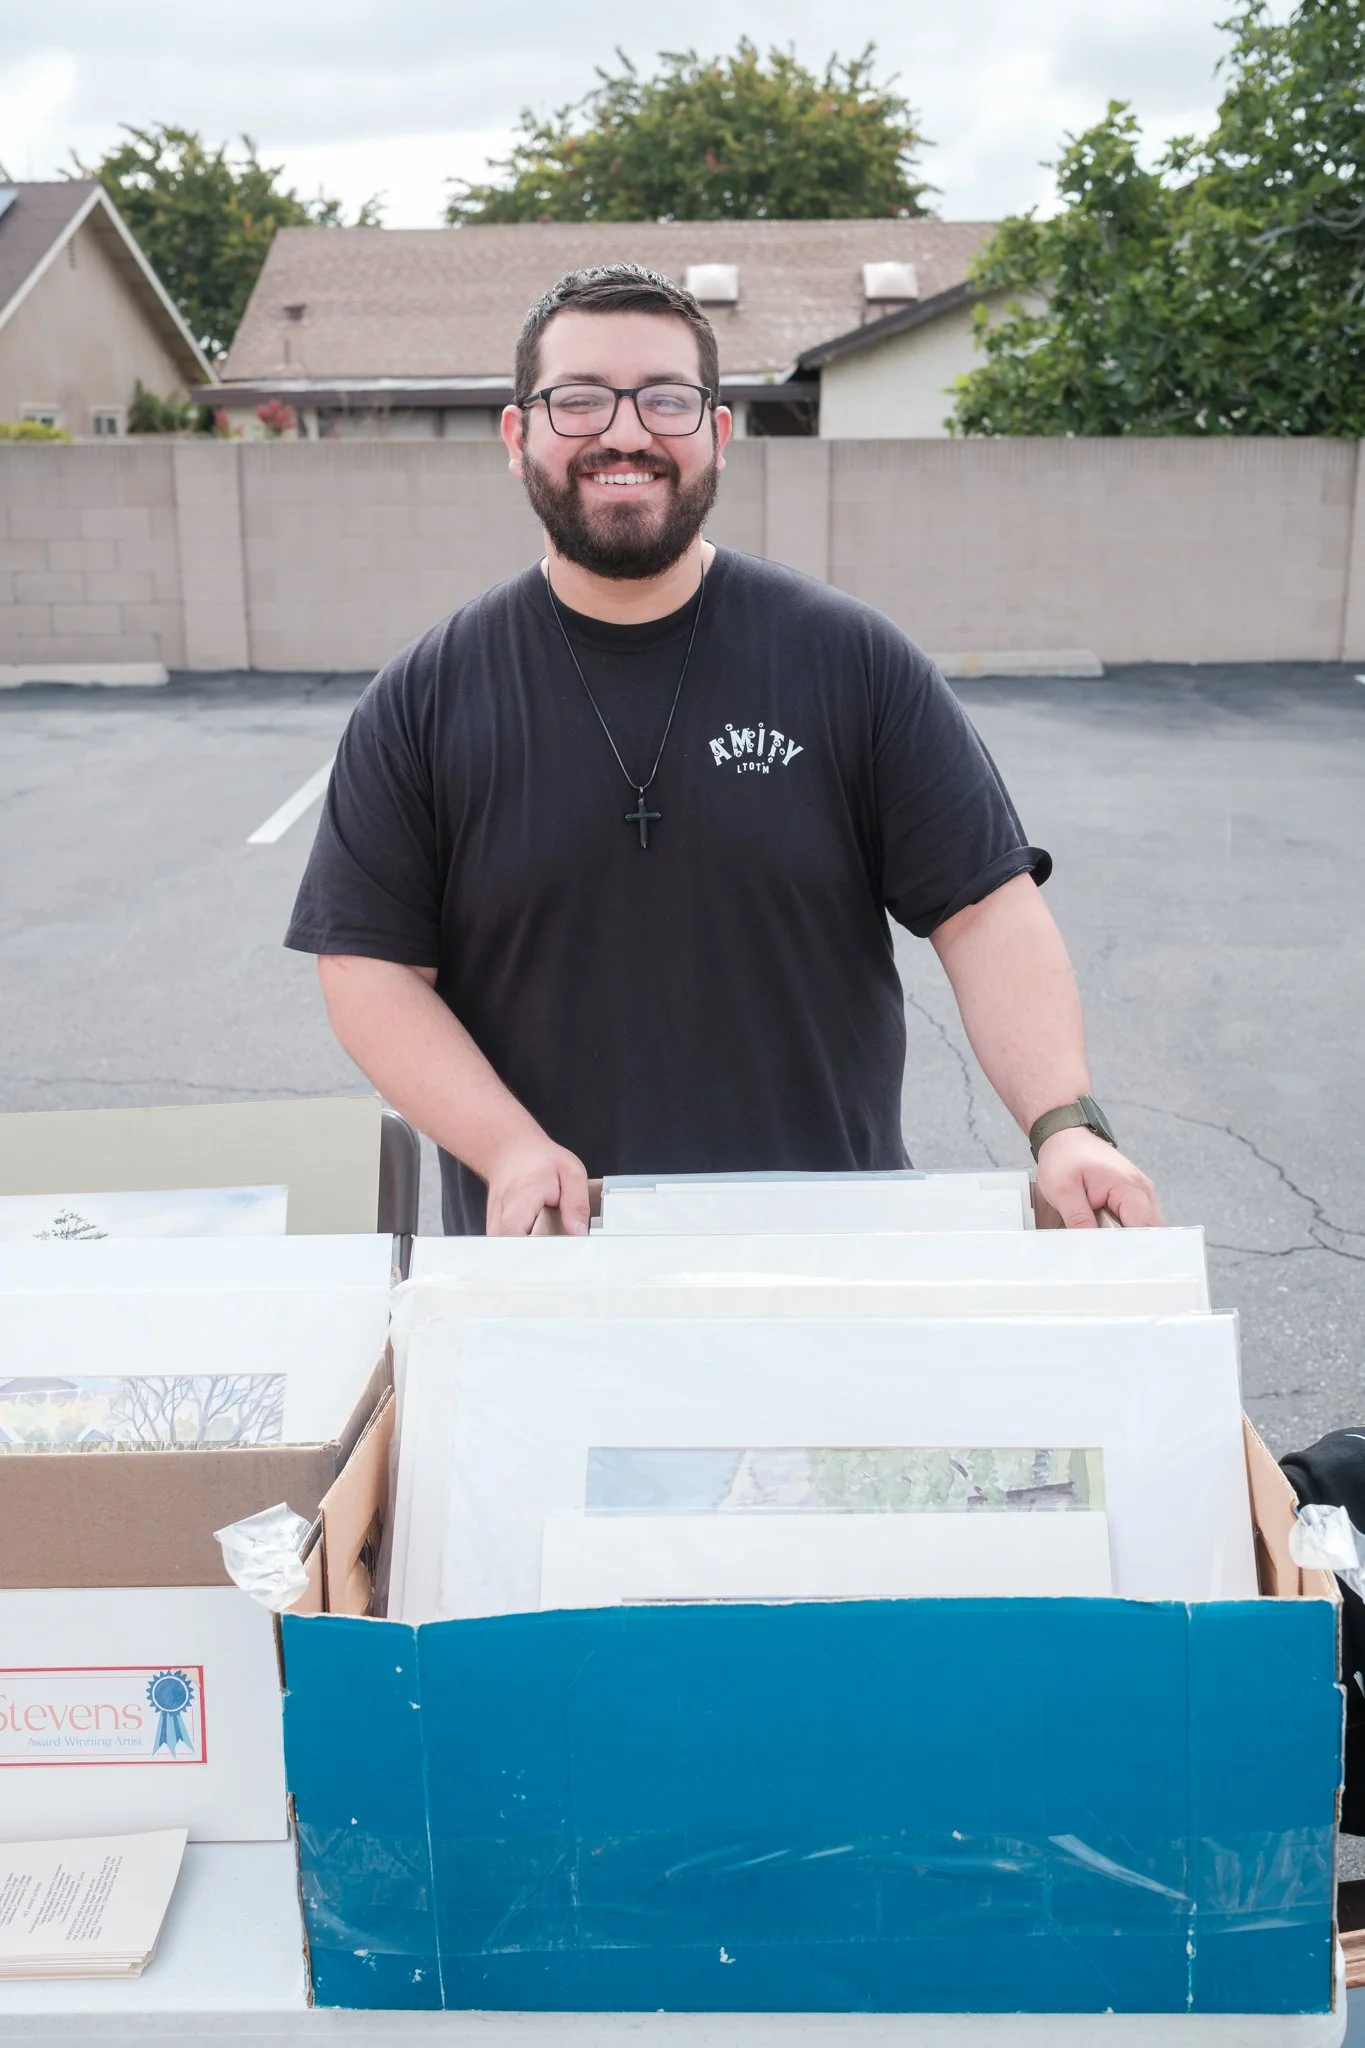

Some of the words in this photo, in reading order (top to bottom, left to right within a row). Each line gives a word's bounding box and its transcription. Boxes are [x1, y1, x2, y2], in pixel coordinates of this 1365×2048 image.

[708, 722, 804, 766] AMITY
[737, 762, 769, 774] LTOTM
[27, 1737, 60, 1747] Award
[64, 1736, 112, 1747] Winning
[115, 1736, 143, 1746] Artist
